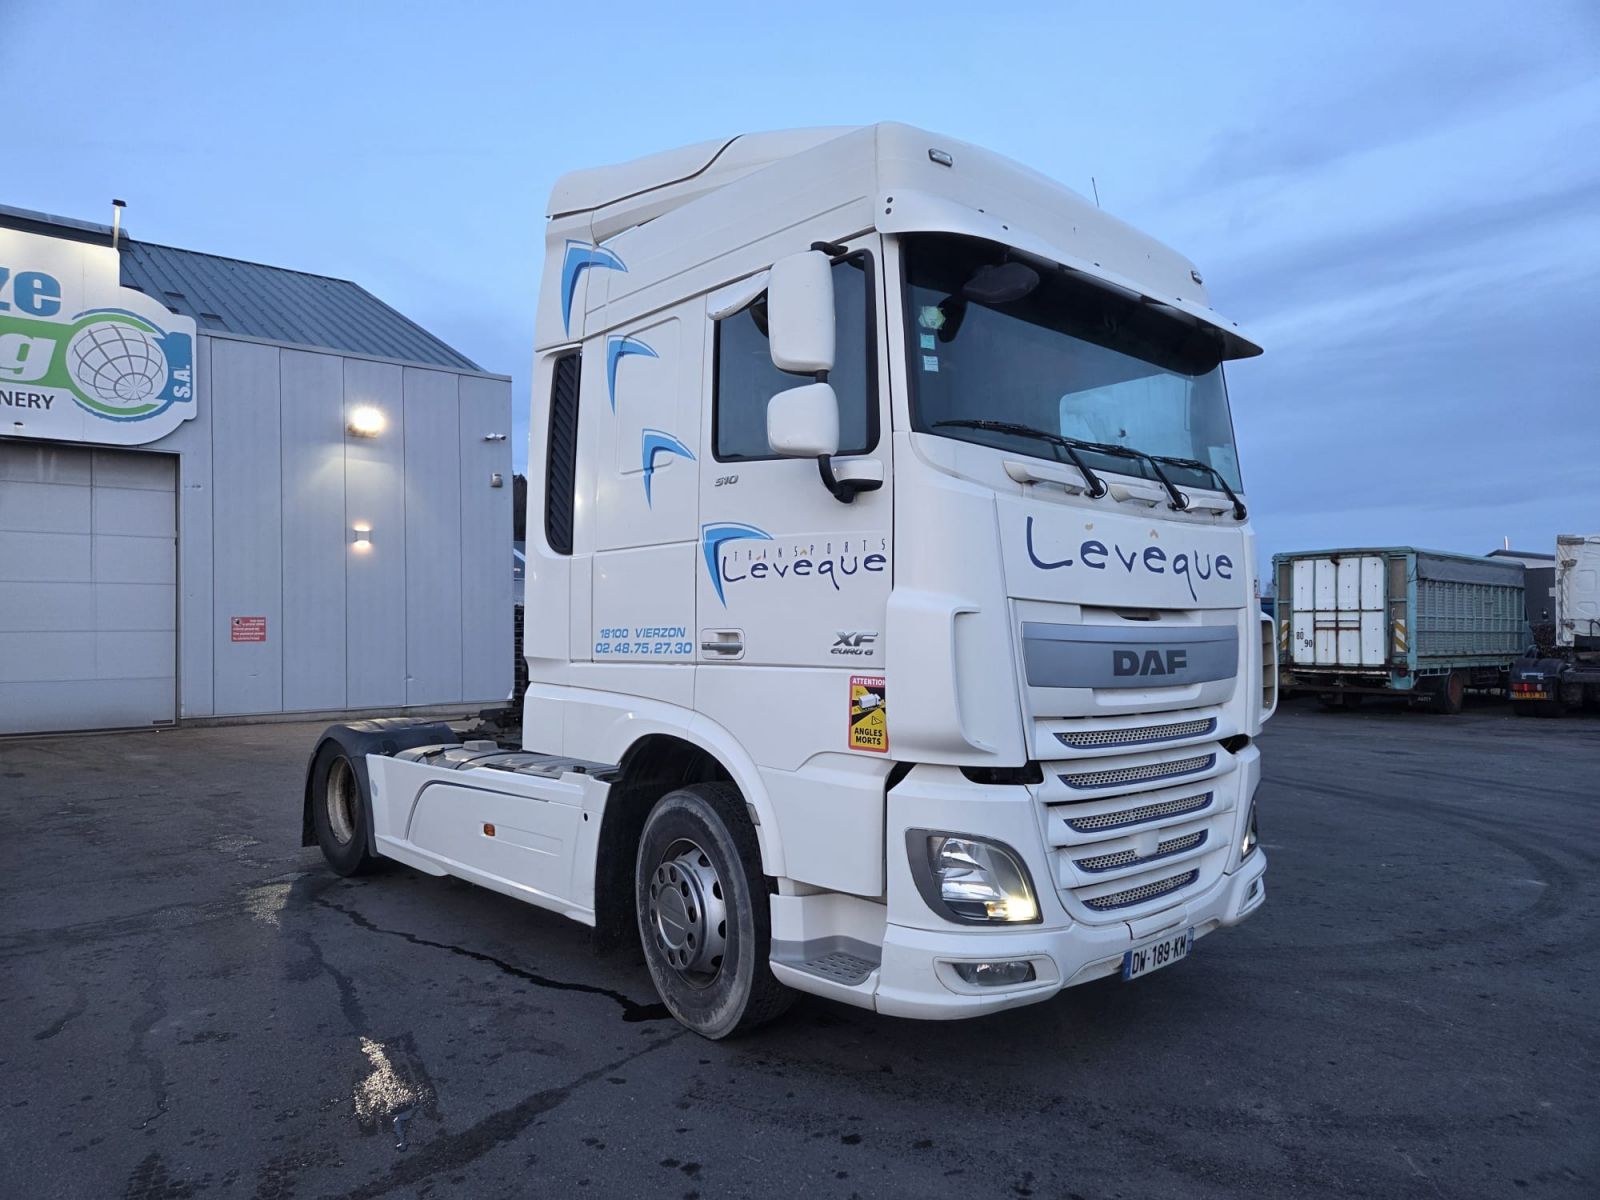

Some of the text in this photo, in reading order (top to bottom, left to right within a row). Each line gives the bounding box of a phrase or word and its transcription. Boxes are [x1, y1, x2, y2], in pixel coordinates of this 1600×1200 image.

[173, 364, 191, 398] S.A.
[714, 474, 739, 487] 510
[734, 539, 886, 561] TRANSPORTS
[600, 627, 686, 639] 18100 VIERZON
[832, 631, 879, 647] XF
[595, 642, 693, 654] 02.48.75.27.30
[1304, 639, 1313, 648] 90
[1112, 649, 1187, 676] DAF
[854, 727, 883, 738] ANGLES
[855, 735, 882, 746] MORTS
